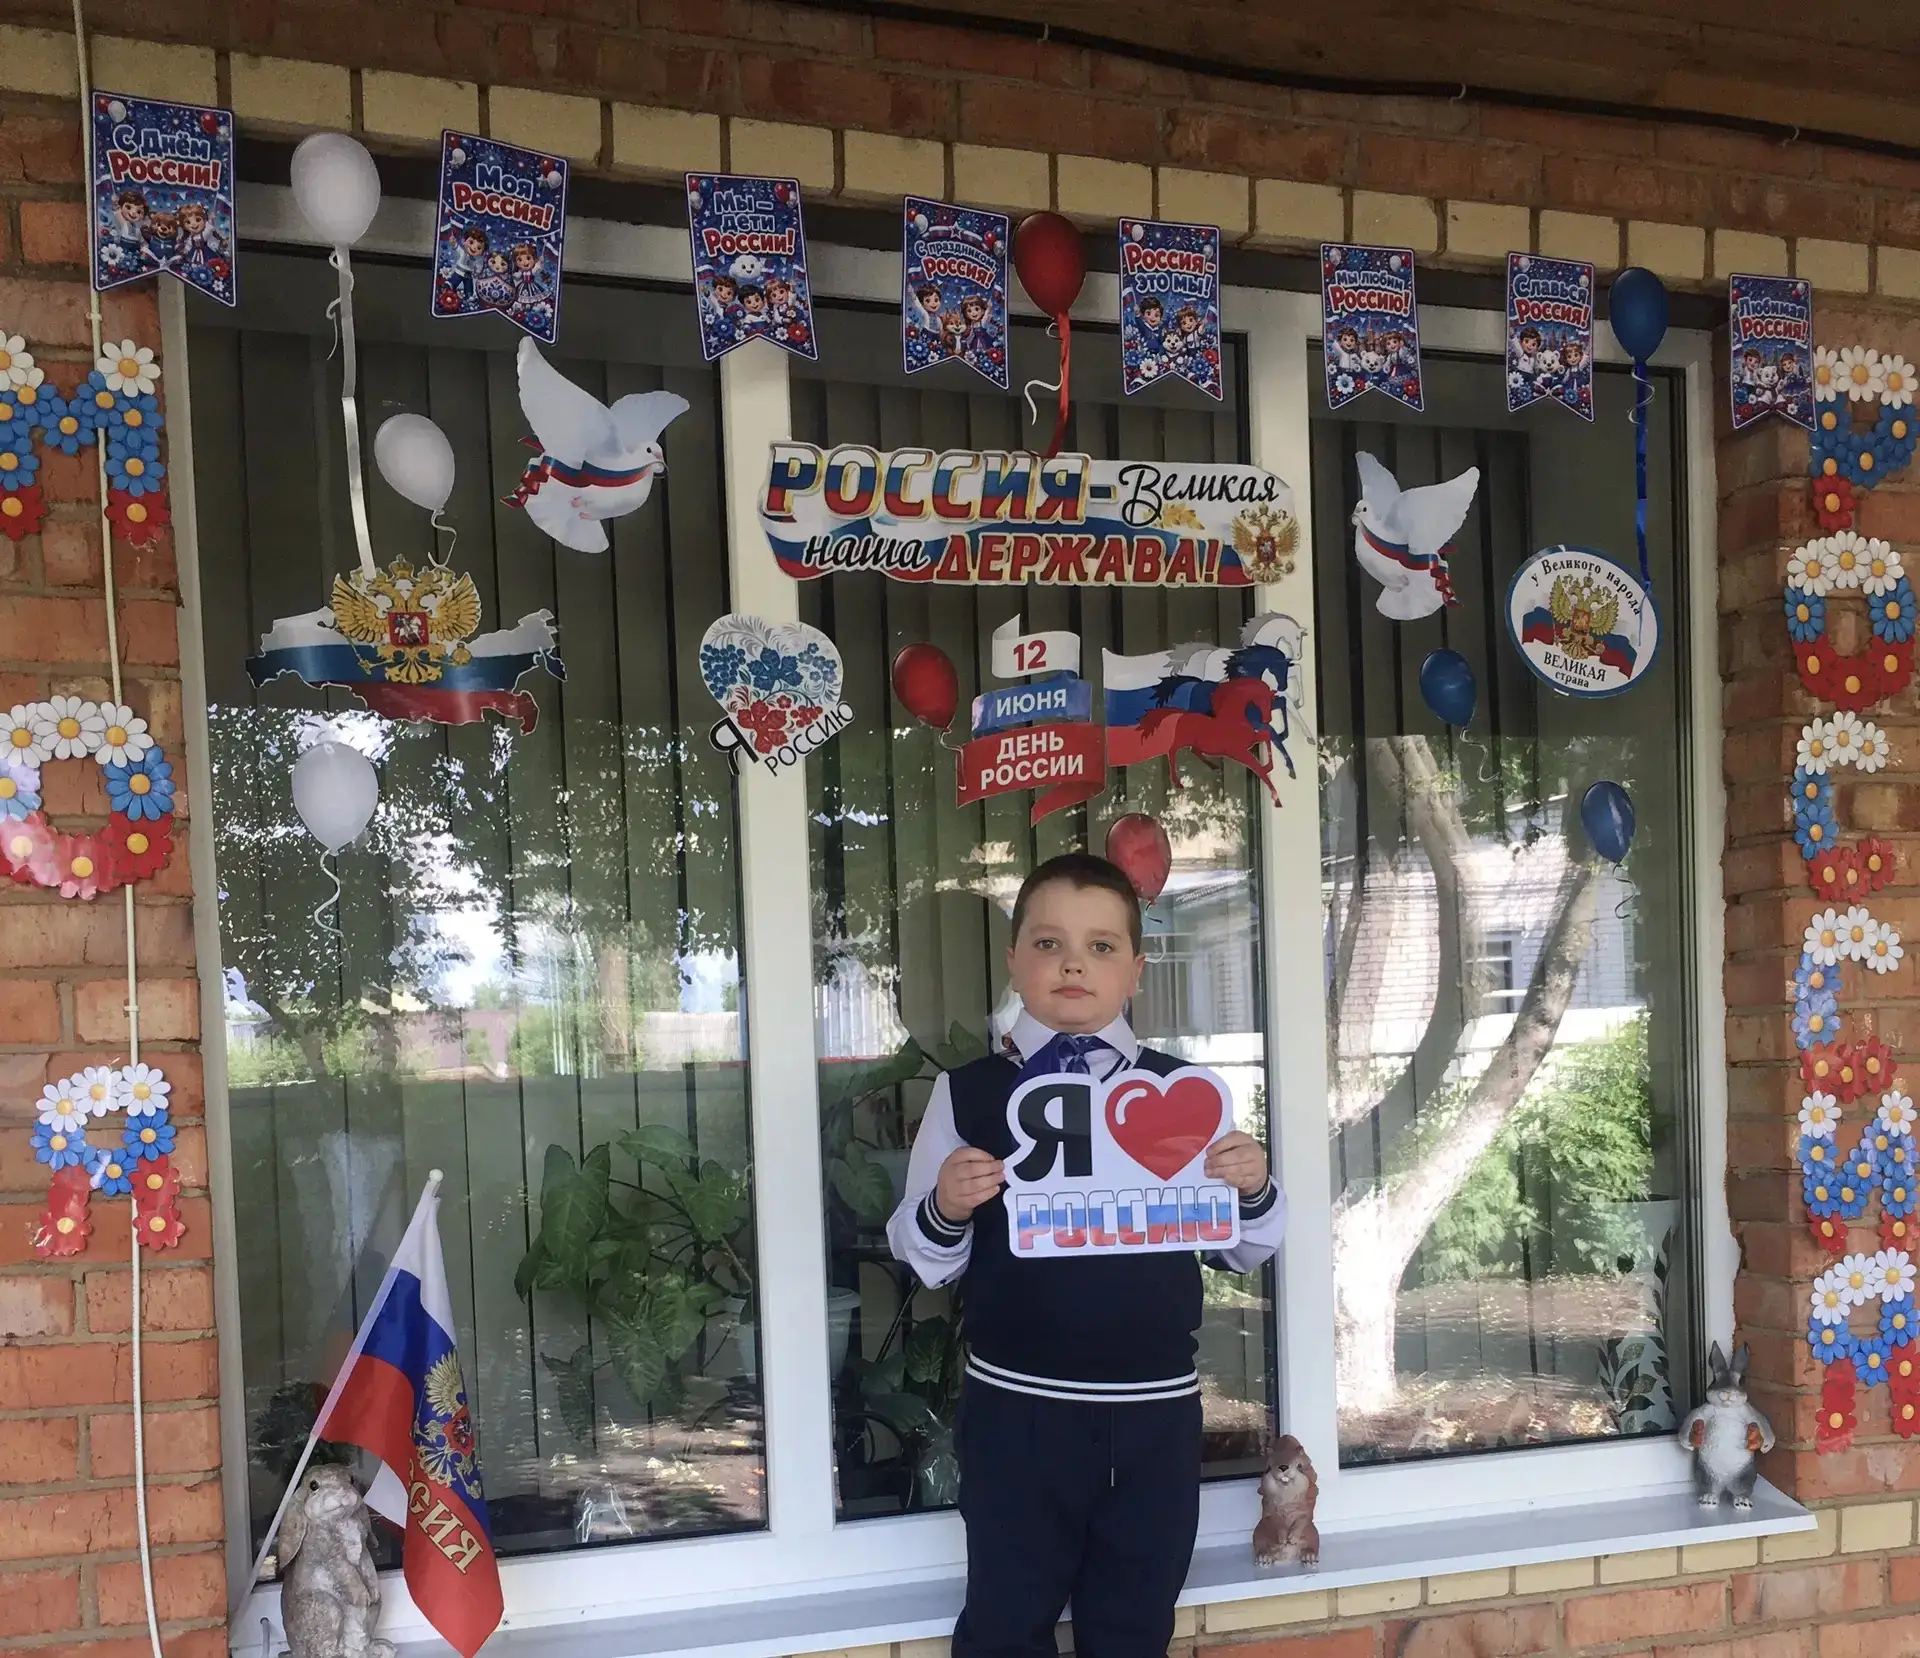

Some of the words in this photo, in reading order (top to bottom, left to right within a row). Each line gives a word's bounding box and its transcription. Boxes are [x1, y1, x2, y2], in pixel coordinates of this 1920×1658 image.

[113, 124, 138, 154] С
[140, 128, 210, 161] Днём
[106, 150, 221, 191] России!
[476, 163, 534, 201] Моя
[453, 182, 555, 230] Россия!
[702, 228, 795, 257] России!
[921, 256, 996, 289] Россия!
[1328, 284, 1412, 317] Россию!
[1514, 298, 1591, 329] Россия!
[1738, 297, 1807, 320] Любимая
[1739, 316, 1808, 342] Россия!
[1118, 463, 1279, 528] Великая
[804, 533, 934, 571] наша
[934, 533, 1222, 585] ДЕРЖАВА!
[1541, 558, 1602, 577] Великого
[1606, 571, 1642, 616] народа
[1013, 639, 1048, 672] 12
[1544, 651, 1607, 683] ВЕЛИКАЯ
[1555, 671, 1590, 688] страна
[996, 688, 1067, 718] ИЮНЯ
[709, 716, 759, 775] Я
[764, 701, 856, 777] РОССИЮ
[996, 732, 1064, 763] ДЕНЬ
[980, 754, 1084, 790] РОССИИ
[1012, 1083, 1093, 1182] Я
[1016, 1185, 1233, 1250] РОССИЮ
